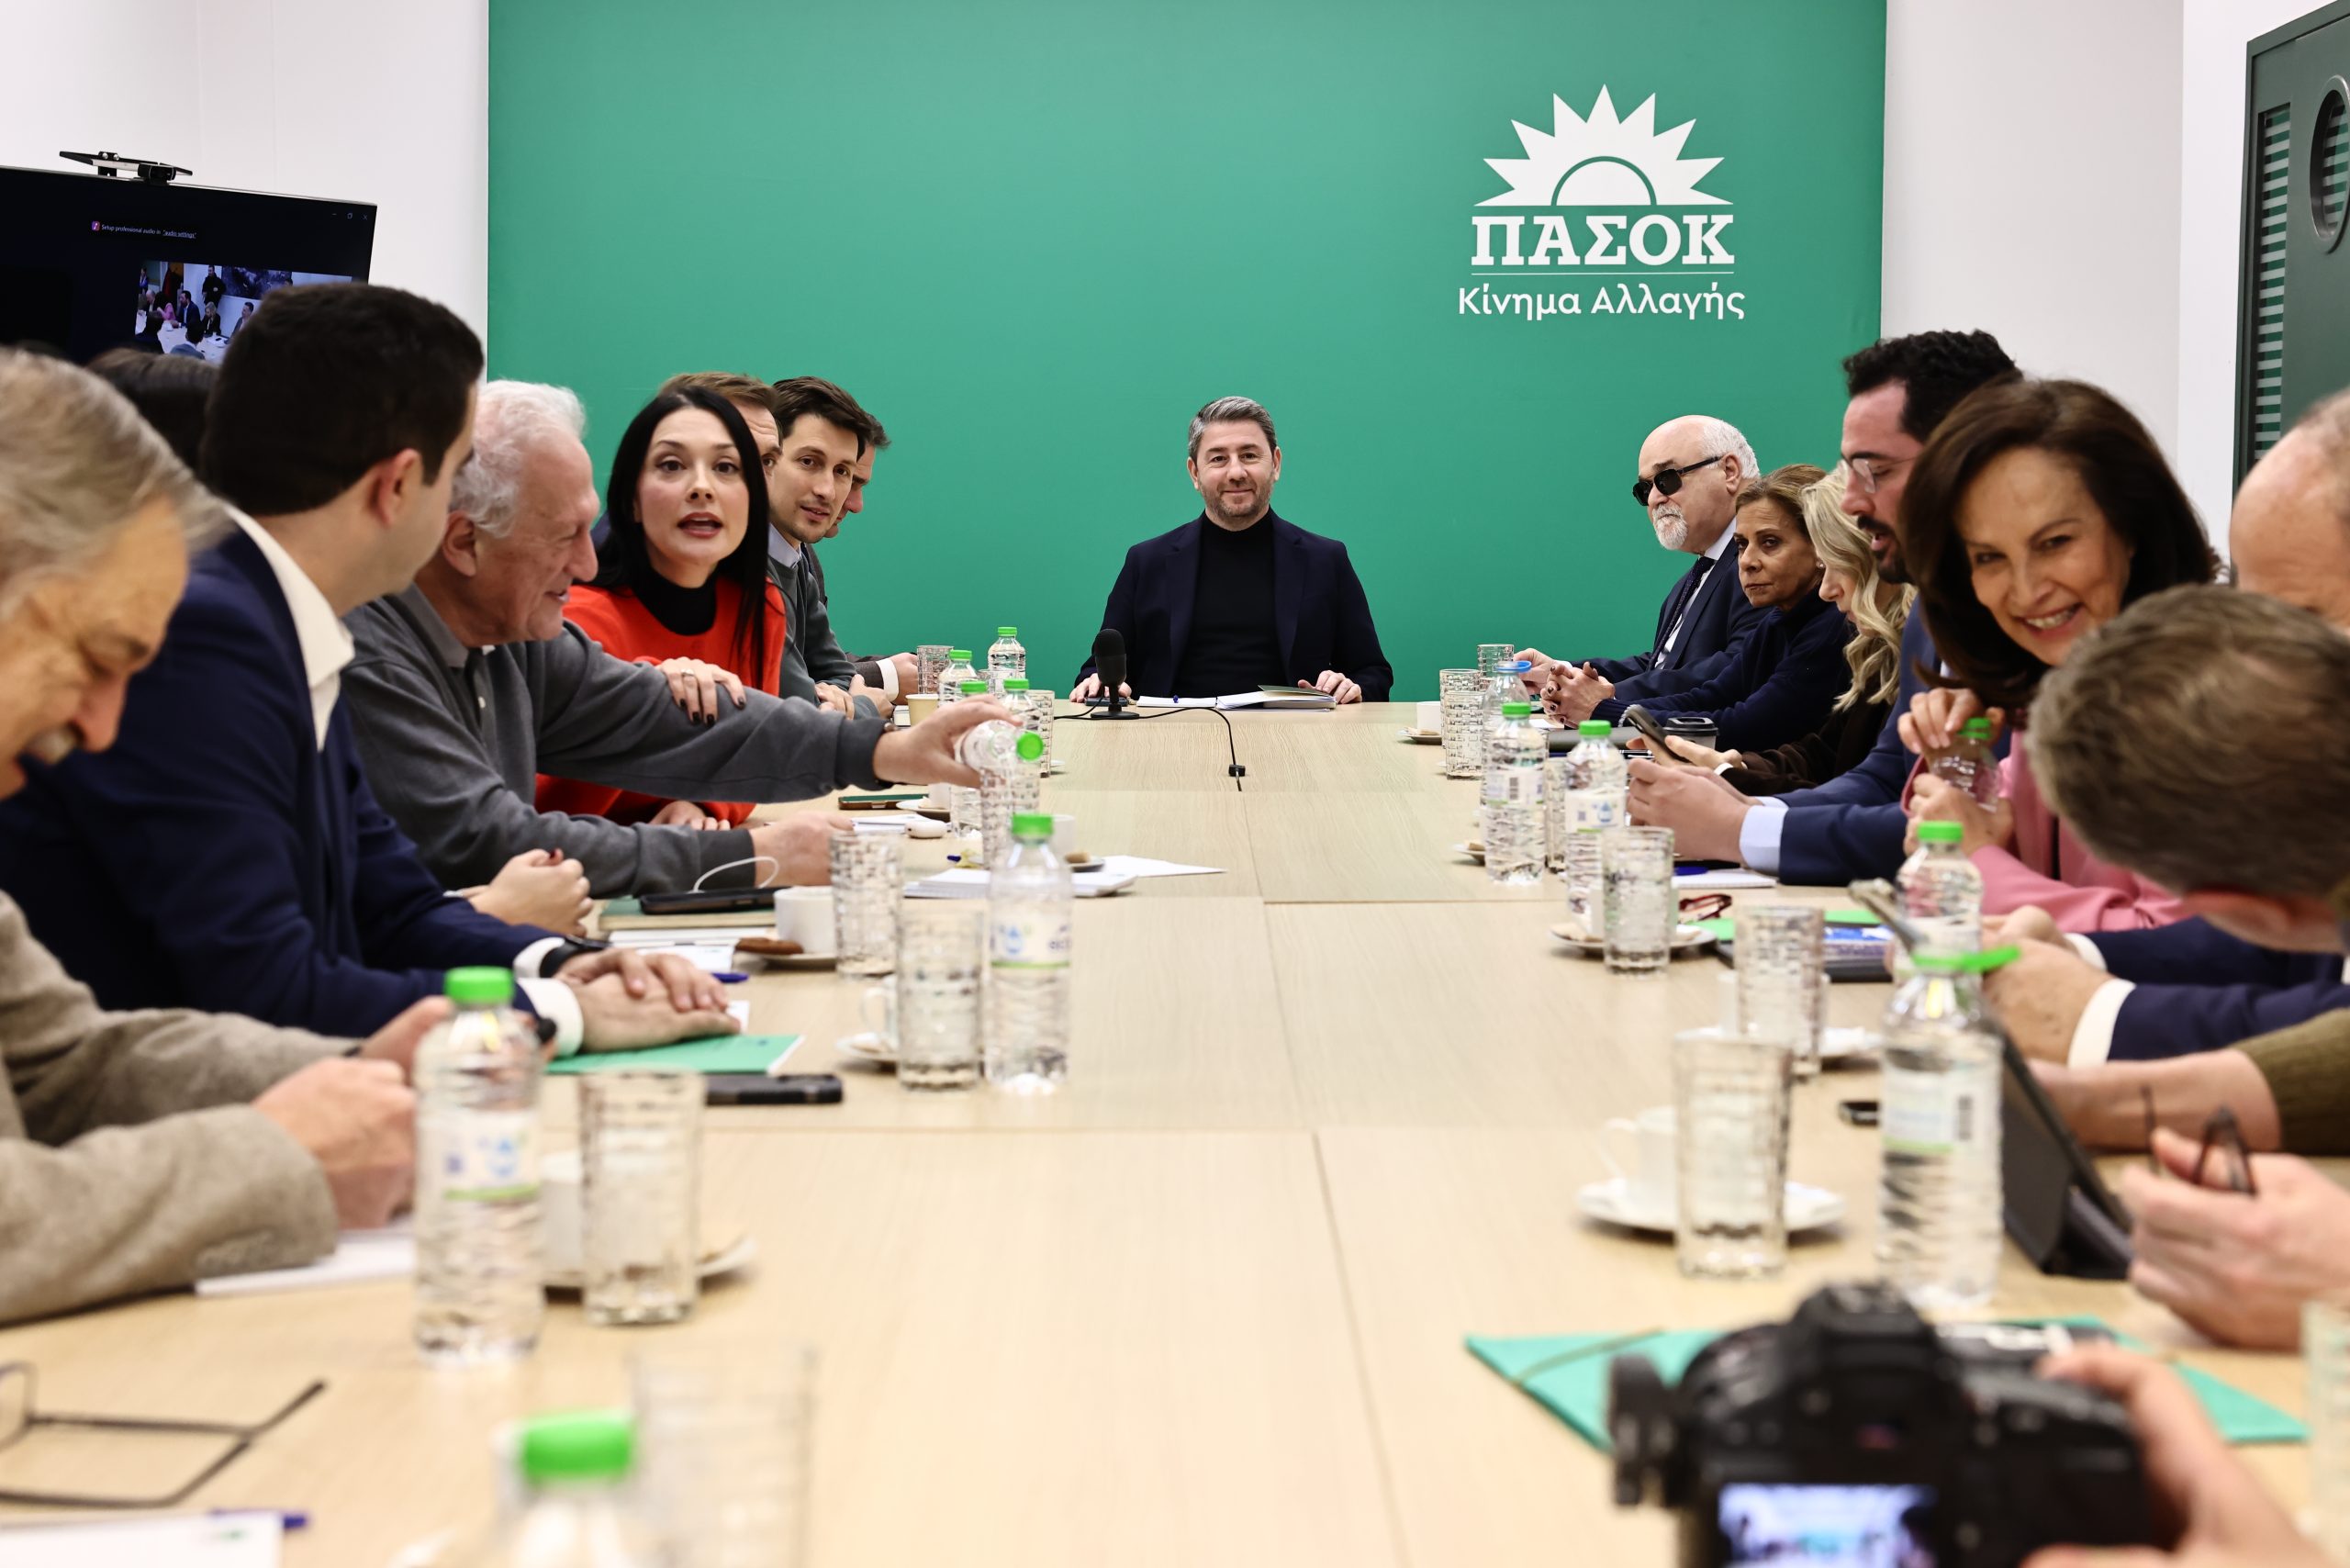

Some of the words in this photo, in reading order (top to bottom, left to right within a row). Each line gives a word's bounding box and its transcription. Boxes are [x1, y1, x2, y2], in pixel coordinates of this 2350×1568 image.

[101, 224, 115, 232] Setup
[115, 225, 142, 233] professional
[1471, 214, 1735, 266] ΠΑΣΟΚ
[1459, 283, 1582, 321] Κίνημα
[1590, 281, 1746, 320] Αλλαγής
